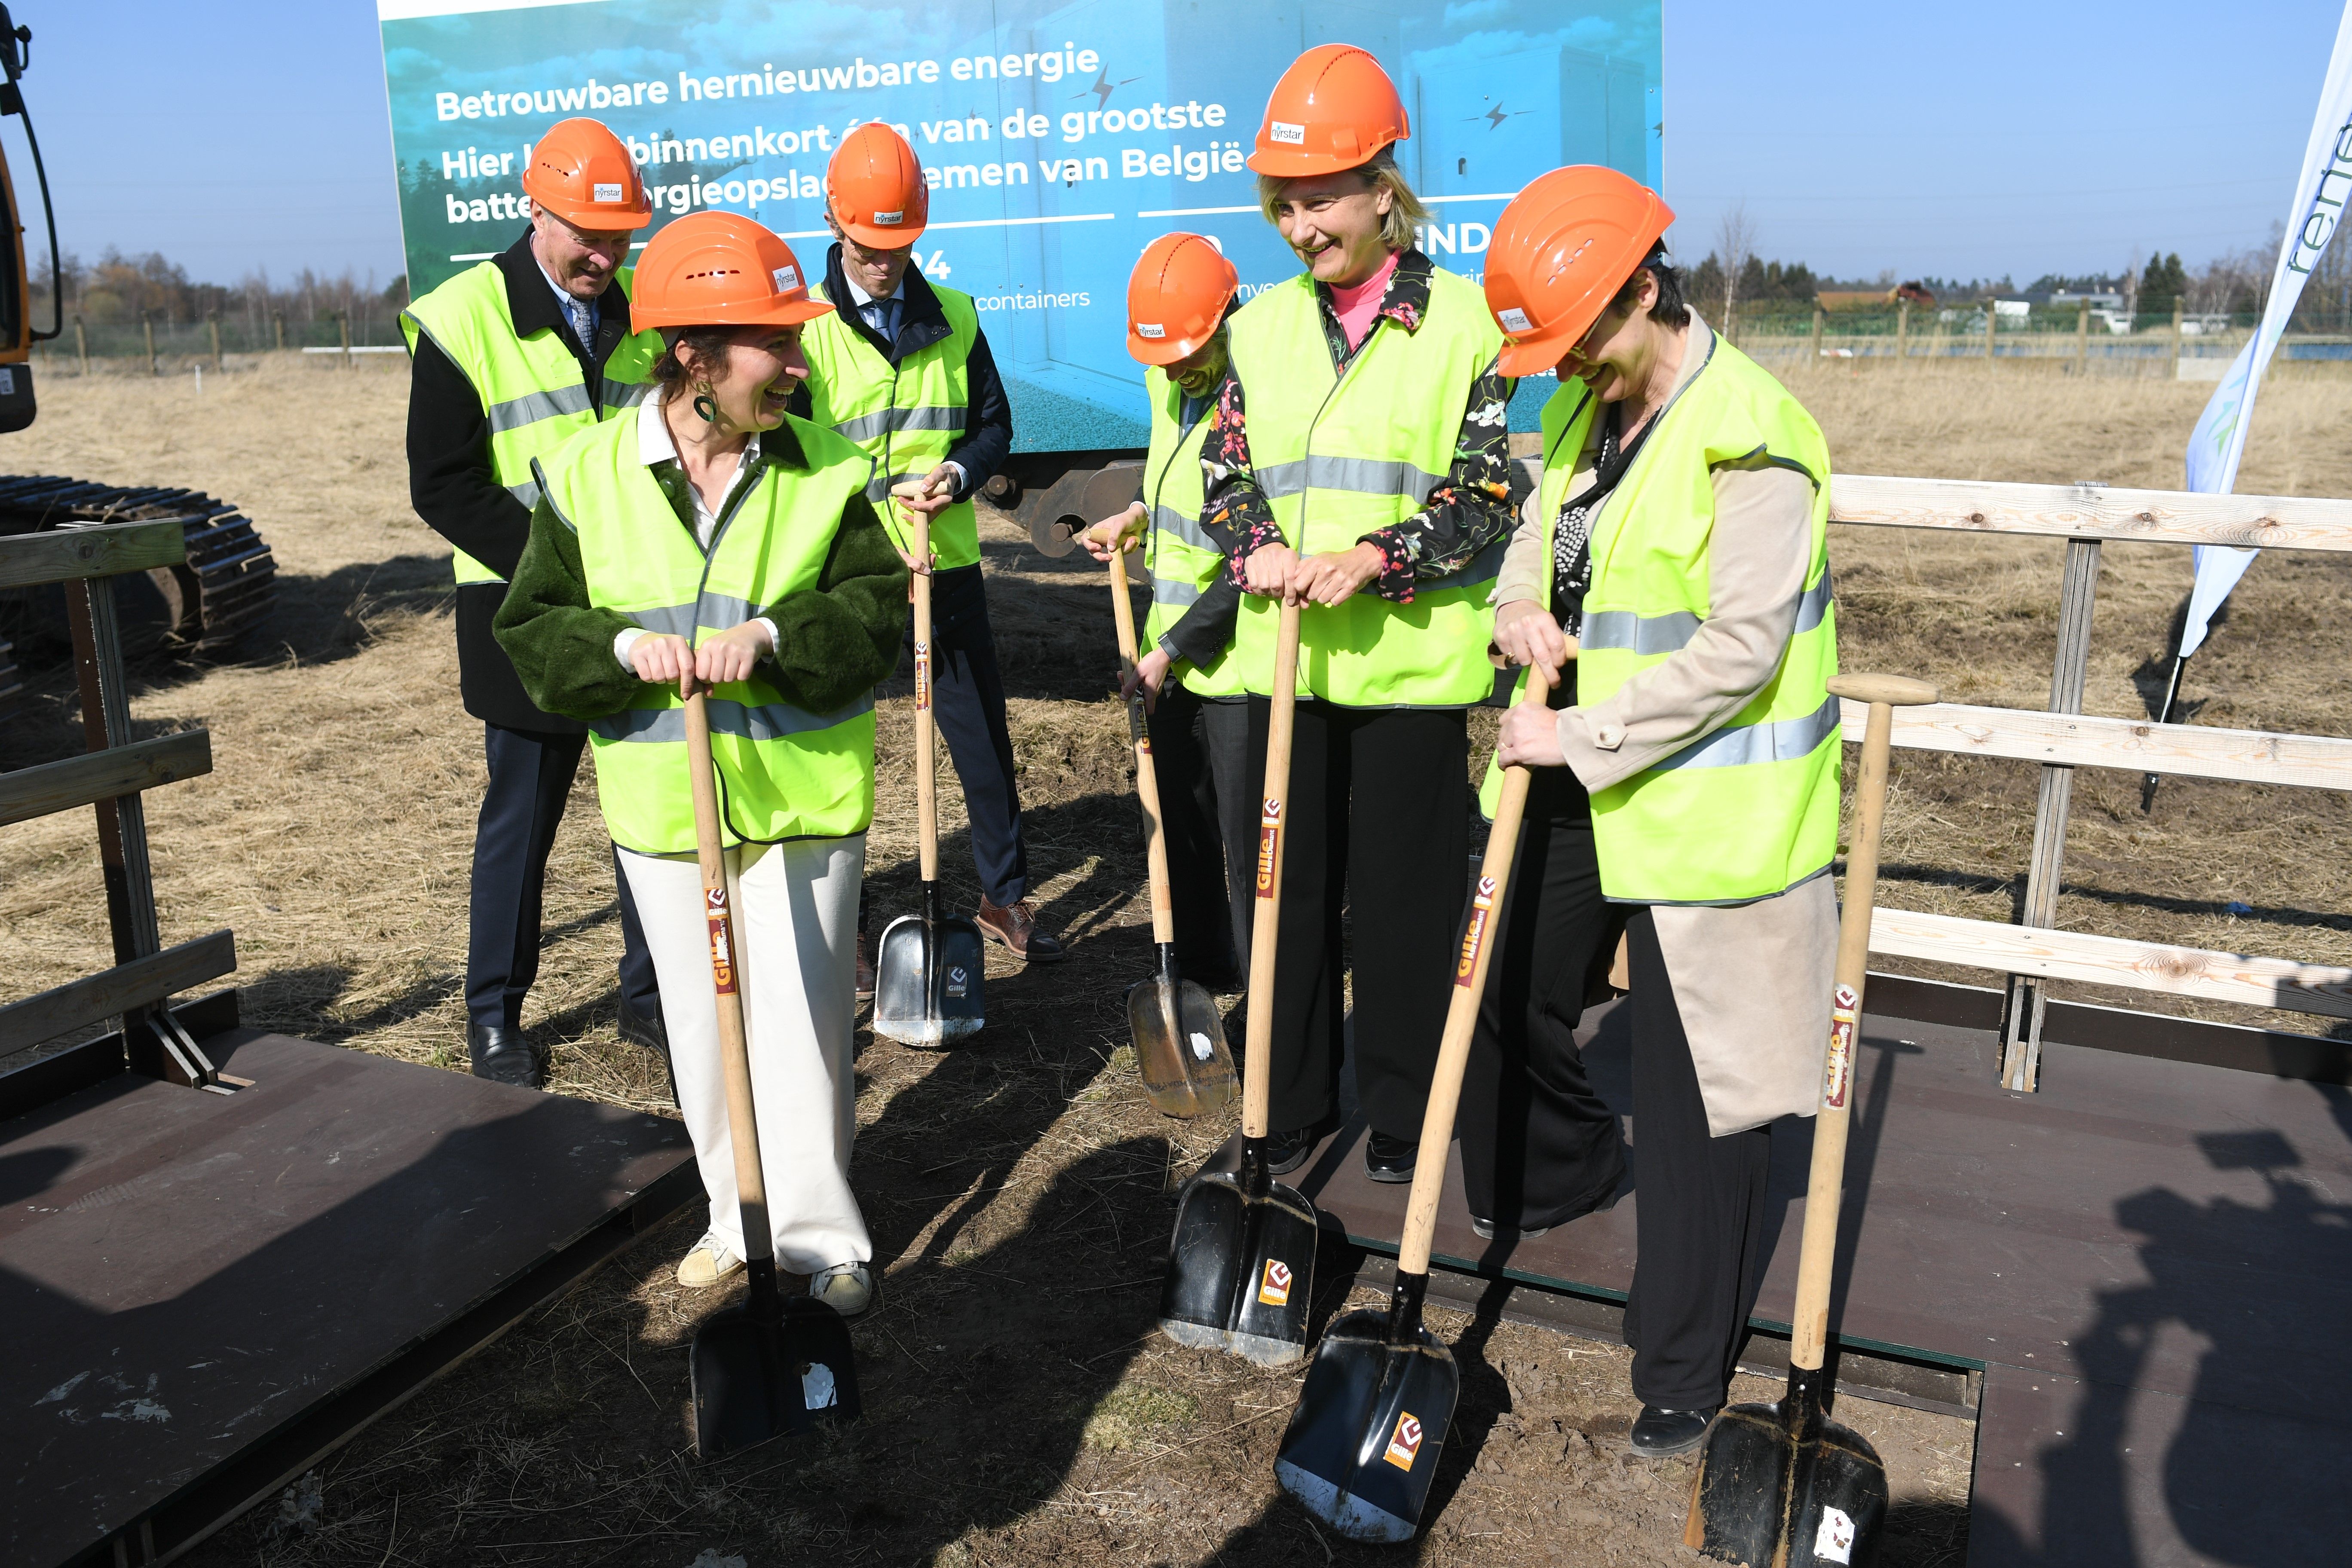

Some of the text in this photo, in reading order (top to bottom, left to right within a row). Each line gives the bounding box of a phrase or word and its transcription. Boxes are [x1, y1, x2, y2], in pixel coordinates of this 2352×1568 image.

[436, 41, 1099, 121] Betrouwbare hernieuwbare energie
[442, 146, 513, 179] Hier
[627, 125, 832, 165] binnenkort
[920, 118, 988, 144] van
[1002, 108, 1050, 139] de
[1061, 101, 1226, 142] grootste
[1272, 129, 1302, 139] nyrstar
[1039, 156, 1108, 182] van
[1122, 141, 1244, 181] België
[595, 189, 620, 198] nyrstar
[776, 273, 795, 287] nyrstar
[976, 289, 1091, 311] containers
[1258, 839, 1271, 890] Gille
[708, 907, 727, 916] Gille
[1391, 1443, 1413, 1461] Gille
